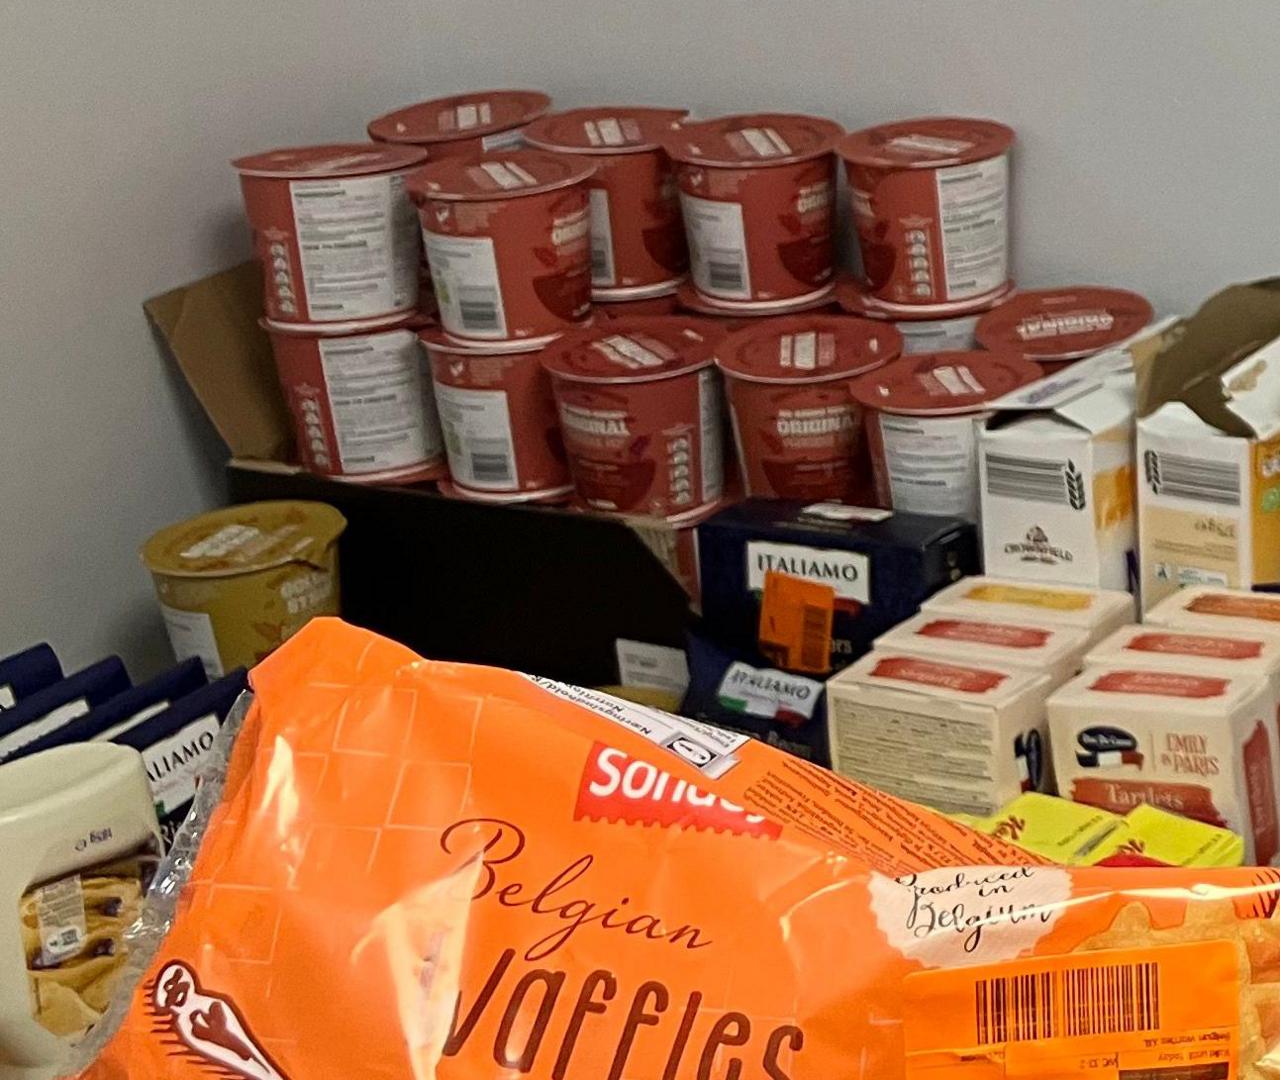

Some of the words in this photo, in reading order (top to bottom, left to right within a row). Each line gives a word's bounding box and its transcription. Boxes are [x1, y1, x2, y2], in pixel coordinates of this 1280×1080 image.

[756, 553, 859, 582] ITALIAMO
[728, 669, 812, 701] ITALIAMO
[1166, 732, 1208, 754] EMILY
[1173, 754, 1221, 777] PARIS
[1106, 783, 1185, 808] Tartlets
[440, 818, 714, 962] Belgian
[895, 866, 1035, 930] Produced
[978, 884, 1014, 898] in
[913, 902, 1054, 953] Belgium
